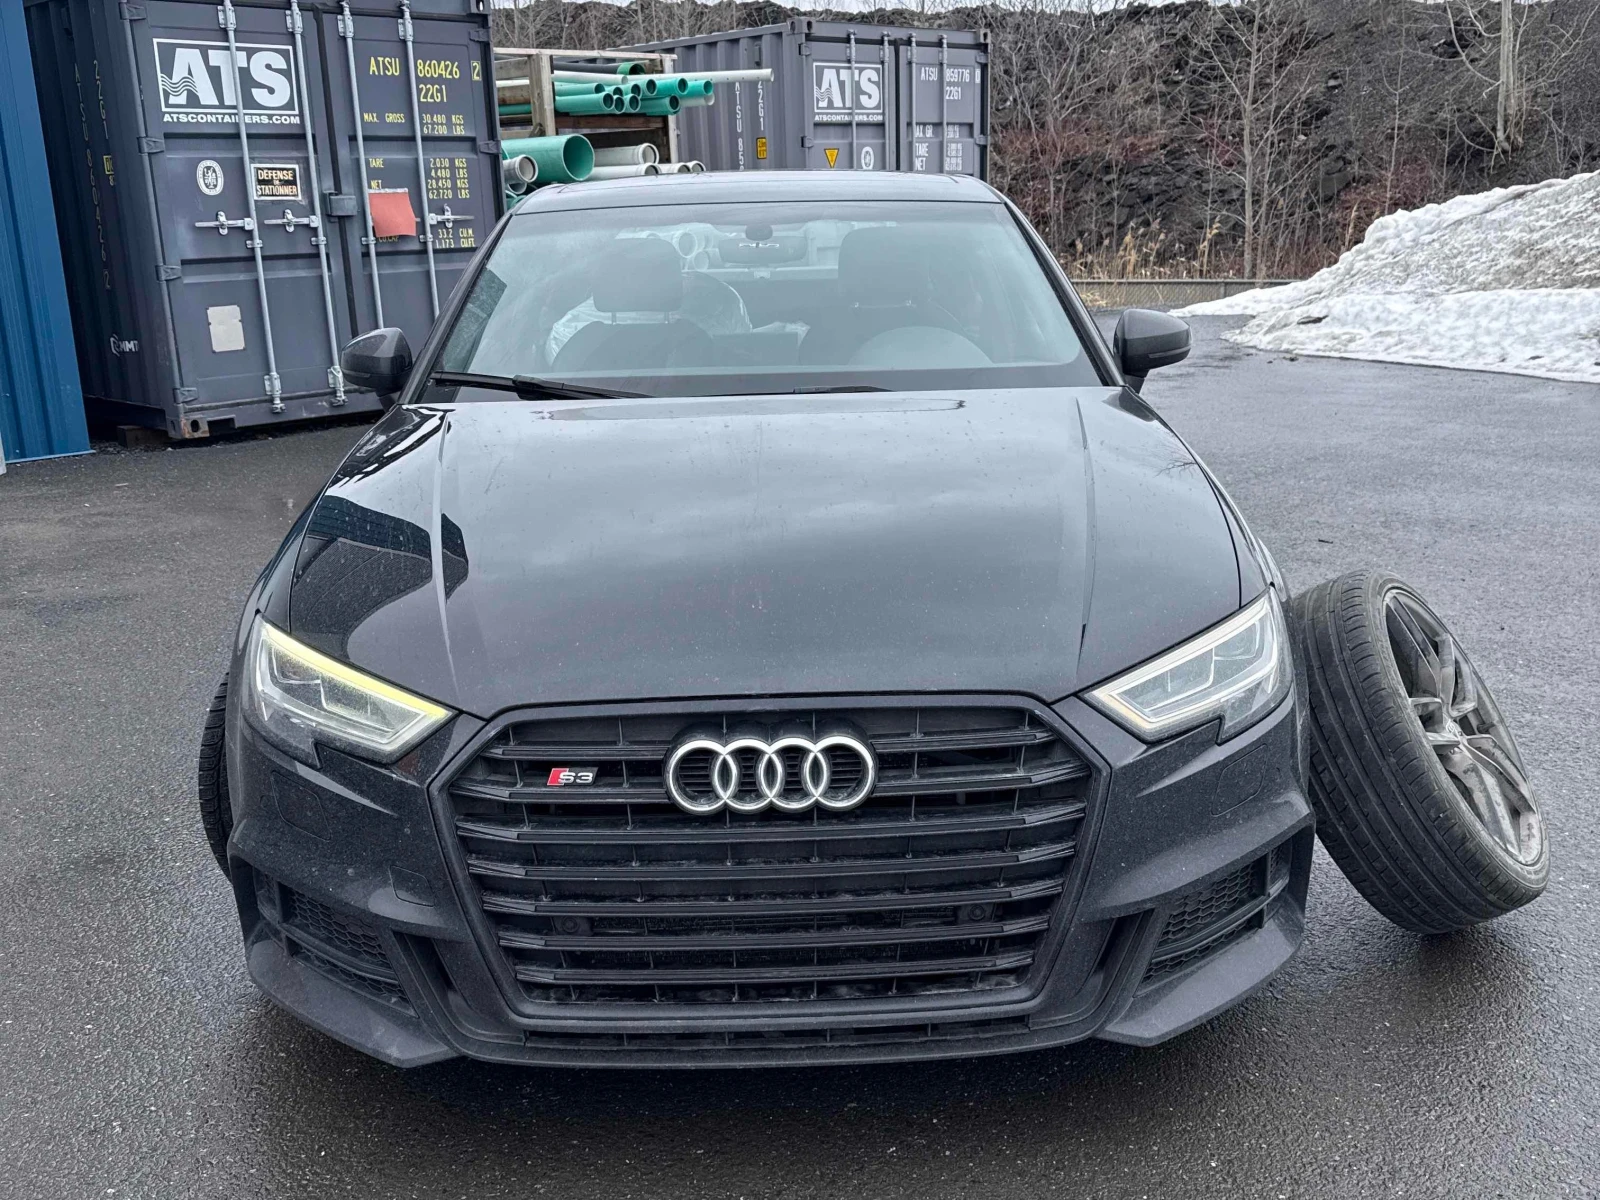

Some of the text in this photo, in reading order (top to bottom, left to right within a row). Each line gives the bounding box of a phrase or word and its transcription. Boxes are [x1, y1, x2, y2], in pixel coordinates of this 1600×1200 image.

[369, 57, 481, 80] ATSU 860426 2
[920, 67, 938, 80] ATSU
[168, 48, 291, 107] ATS
[419, 84, 447, 102] 22G1
[817, 68, 880, 108] ATS
[363, 112, 464, 124] MAX. GROSS 30.480 KGS
[423, 125, 465, 135] 67.200 LBS
[915, 143, 928, 156] TARE
[369, 158, 467, 168] TARE 2.030 KGS
[915, 157, 926, 171] NET
[431, 169, 468, 178] 4.480 LBS
[256, 185, 297, 195] STATIONNER
[371, 180, 469, 189] NET 28.450 KGS
[428, 190, 470, 199] 62.720 LBS
[438, 229, 453, 238] 33.2
[558, 772, 593, 783] S3
